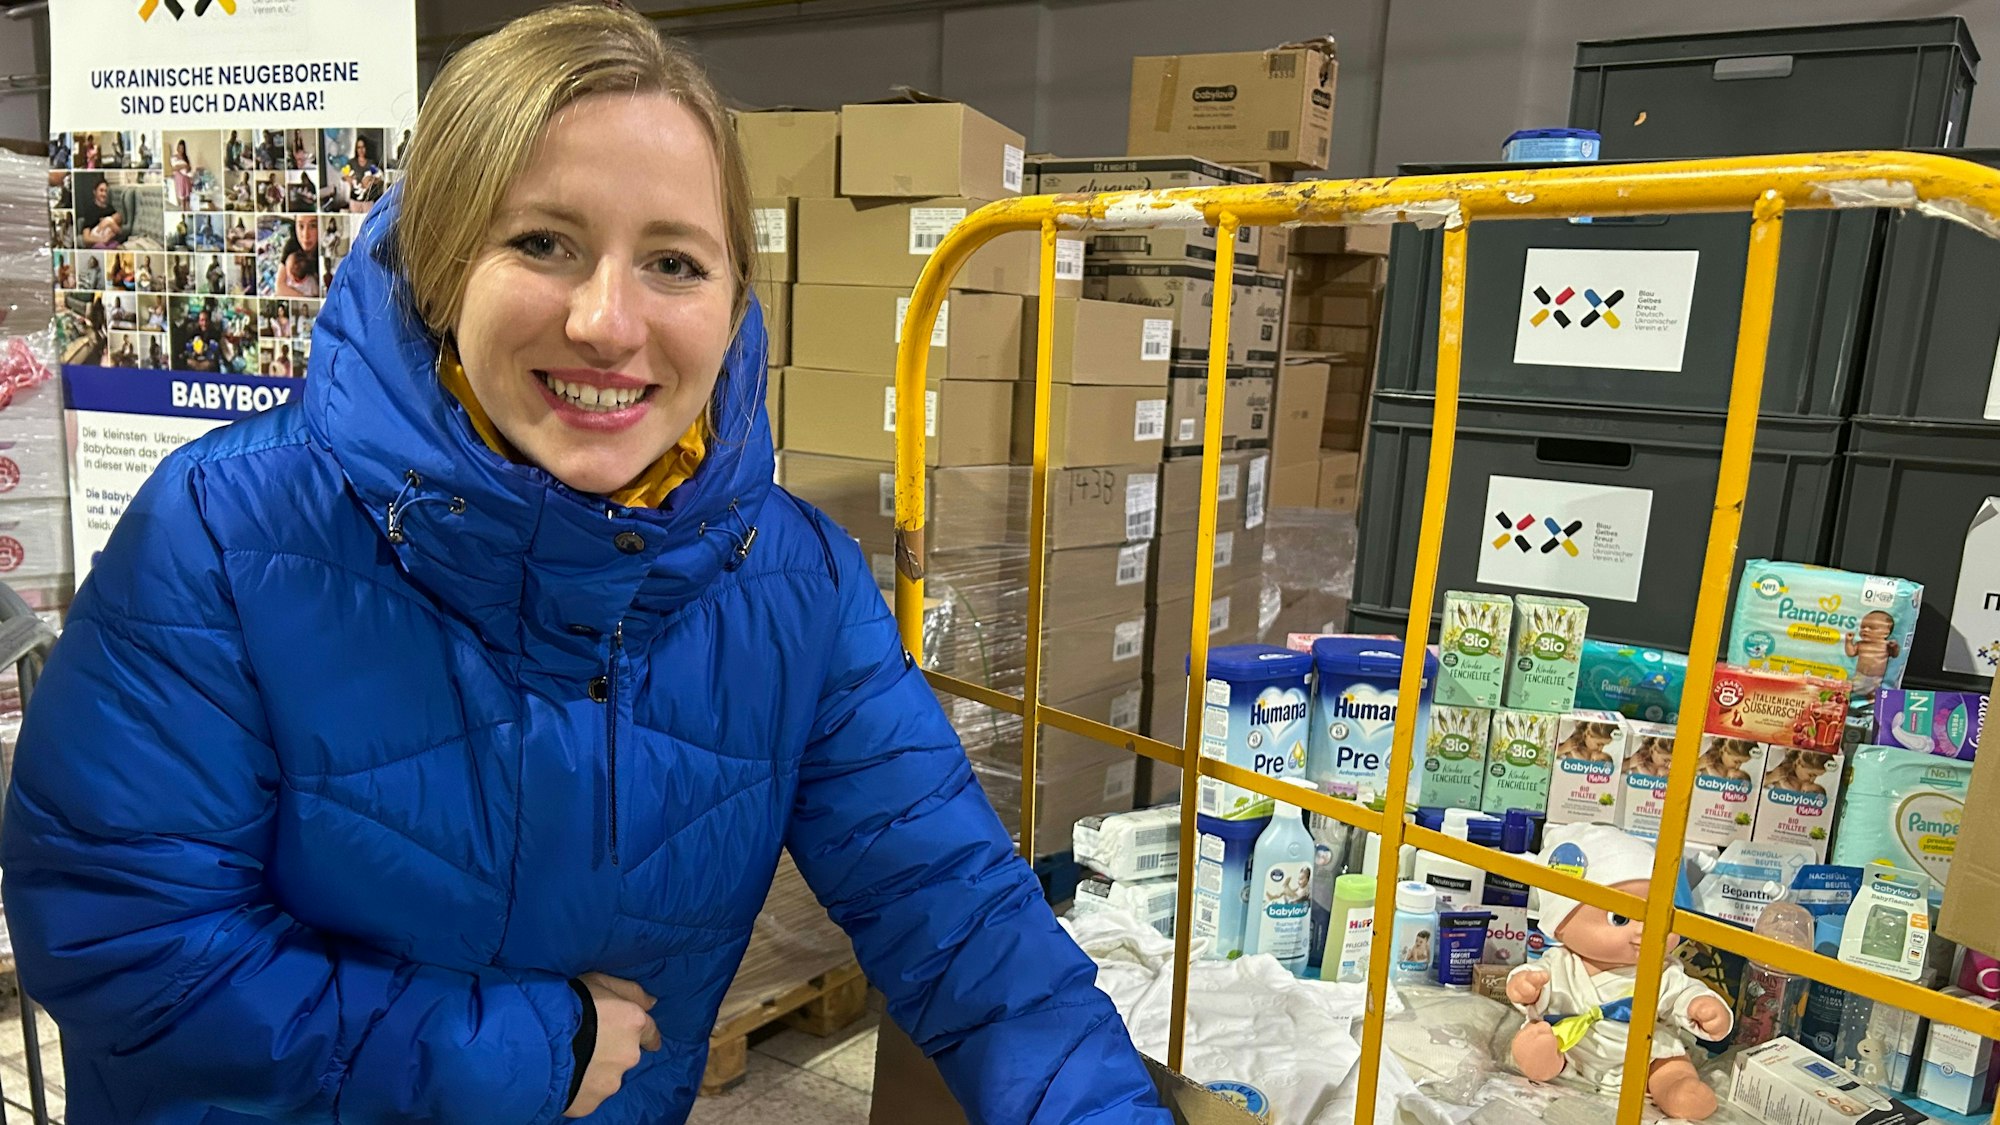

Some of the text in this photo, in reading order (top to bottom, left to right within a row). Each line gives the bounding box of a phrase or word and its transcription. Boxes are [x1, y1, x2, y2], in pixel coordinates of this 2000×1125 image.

[91, 61, 360, 89] UKRAINISCHE NEUGEBORENE
[1194, 88, 1235, 101] babylove
[120, 90, 325, 115] SIND EUCH DANKBAR!
[1637, 296, 1661, 304] Gelbes
[1635, 310, 1664, 318] Deutsch
[82, 426, 97, 438] Die
[103, 427, 147, 443] kleinsten
[83, 442, 158, 459] Babyboxen das
[84, 457, 147, 473] in dieser Welt
[86, 488, 100, 500] Die
[86, 504, 104, 515] und
[1778, 597, 1857, 630] Pampers
[1792, 632, 1835, 643] protection
[1797, 626, 1831, 637] premium
[1464, 632, 1490, 648] Bio
[1539, 637, 1565, 653] Bio
[1460, 658, 1482, 670] Kinder
[1535, 663, 1558, 675] Kinder
[1450, 668, 1491, 682] FENCHELTEE
[1524, 673, 1565, 686] FENCHELTEE
[1601, 679, 1637, 696] Pampers
[1753, 691, 1806, 709] ITALIENISCHE
[1250, 701, 1307, 727] Humana
[1951, 713, 1960, 737] FRESH
[1445, 737, 1470, 753] Bio
[1512, 743, 1537, 760] Bio
[1254, 753, 1285, 775] Pre
[1336, 746, 1380, 770] Pre
[1563, 761, 1612, 775] babylove
[1431, 773, 1472, 785] FENCHELTEE
[1508, 769, 1530, 781] Kinder
[1497, 779, 1538, 792] FENCHELTEE
[1698, 777, 1750, 794] babylove
[1570, 791, 1597, 800] STILLTEE
[1771, 790, 1825, 807] babylove
[1704, 809, 1733, 819] STILLTEE
[1777, 822, 1807, 833] STILLTEE
[1740, 849, 1783, 859] NACHFÜLL-
[1755, 859, 1782, 868] BEUTEL
[1432, 876, 1466, 888] Neutrogena
[1491, 877, 1524, 889] Neutrogena
[1808, 872, 1850, 882] NACHFÜLL-
[1824, 881, 1851, 889] BEUTEL
[1873, 883, 1918, 898] babylove
[1870, 893, 1915, 907] Babyflasche
[1349, 918, 1373, 929] HiPP
[1453, 919, 1482, 927] Neutrogena
